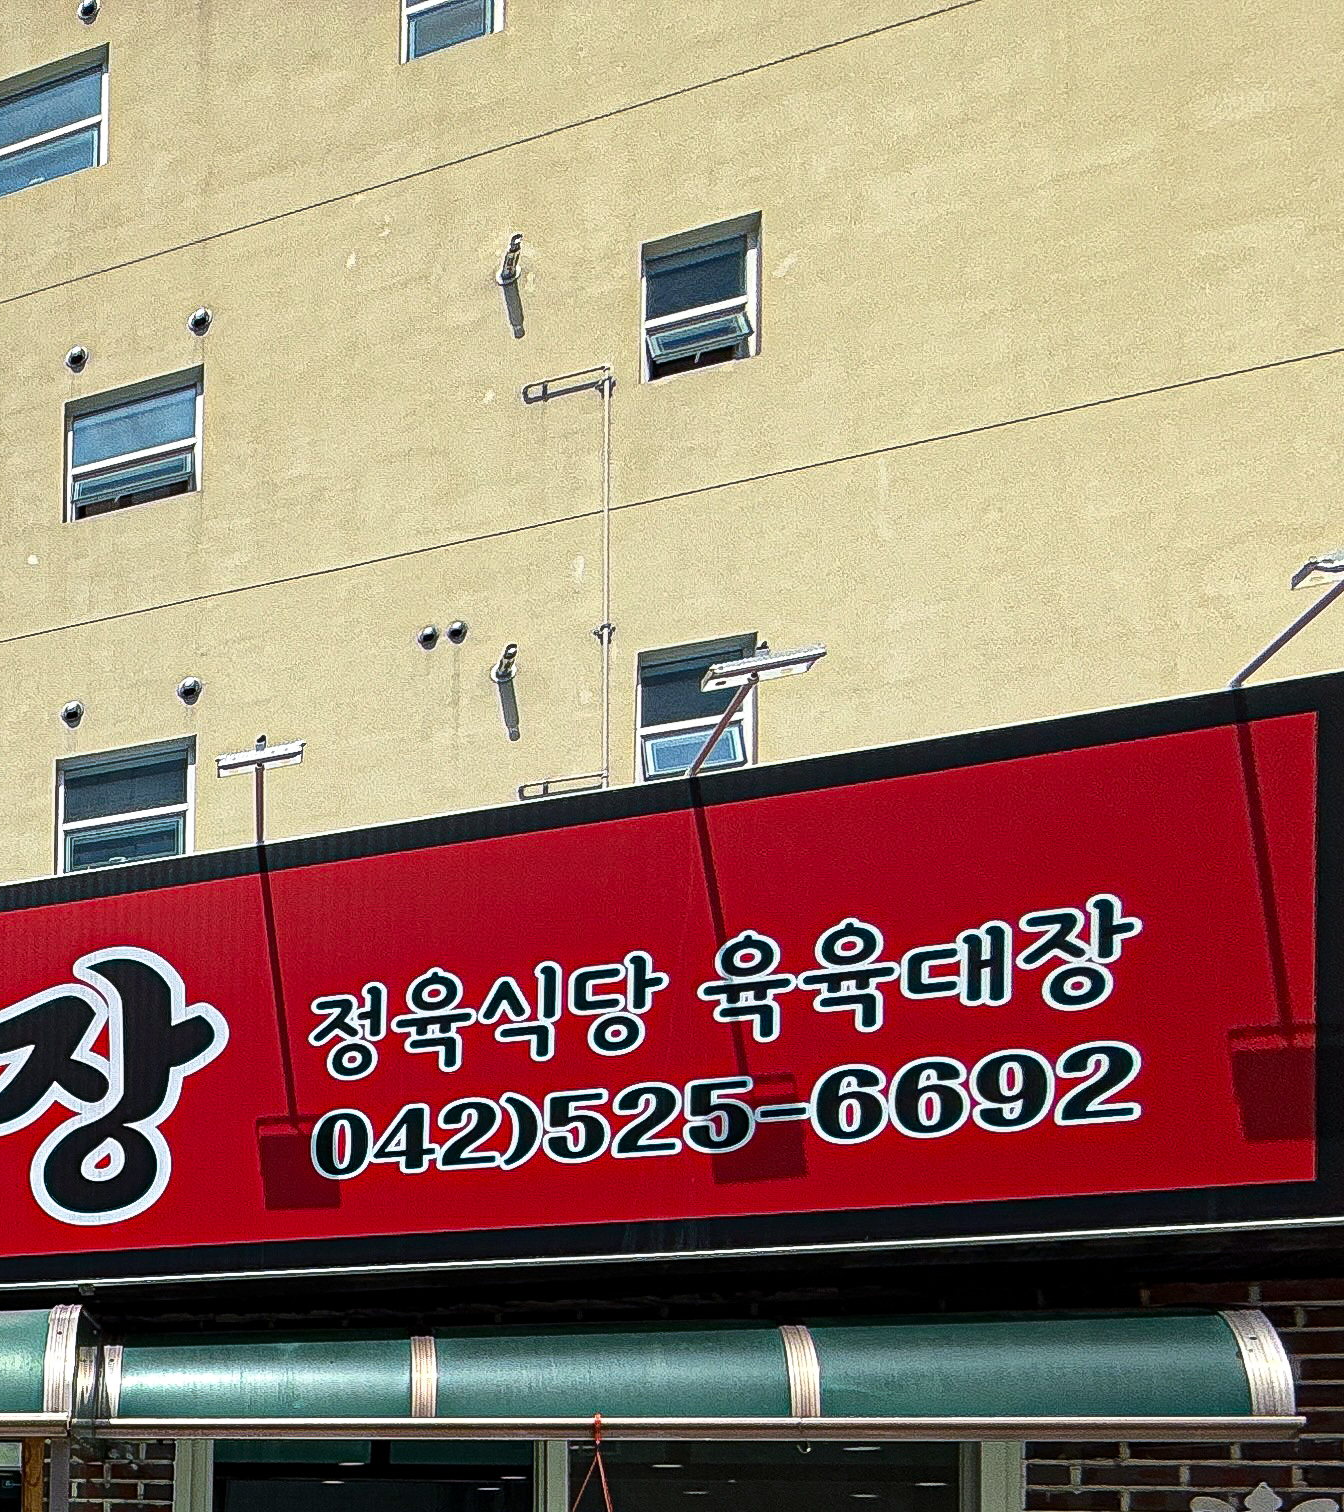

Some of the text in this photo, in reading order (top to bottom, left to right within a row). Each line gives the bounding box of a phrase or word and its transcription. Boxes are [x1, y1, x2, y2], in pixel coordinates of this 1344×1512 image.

[307, 891, 1143, 1083] 정육식당 육육대장
[310, 1039, 1143, 1182] 042)525-6692
